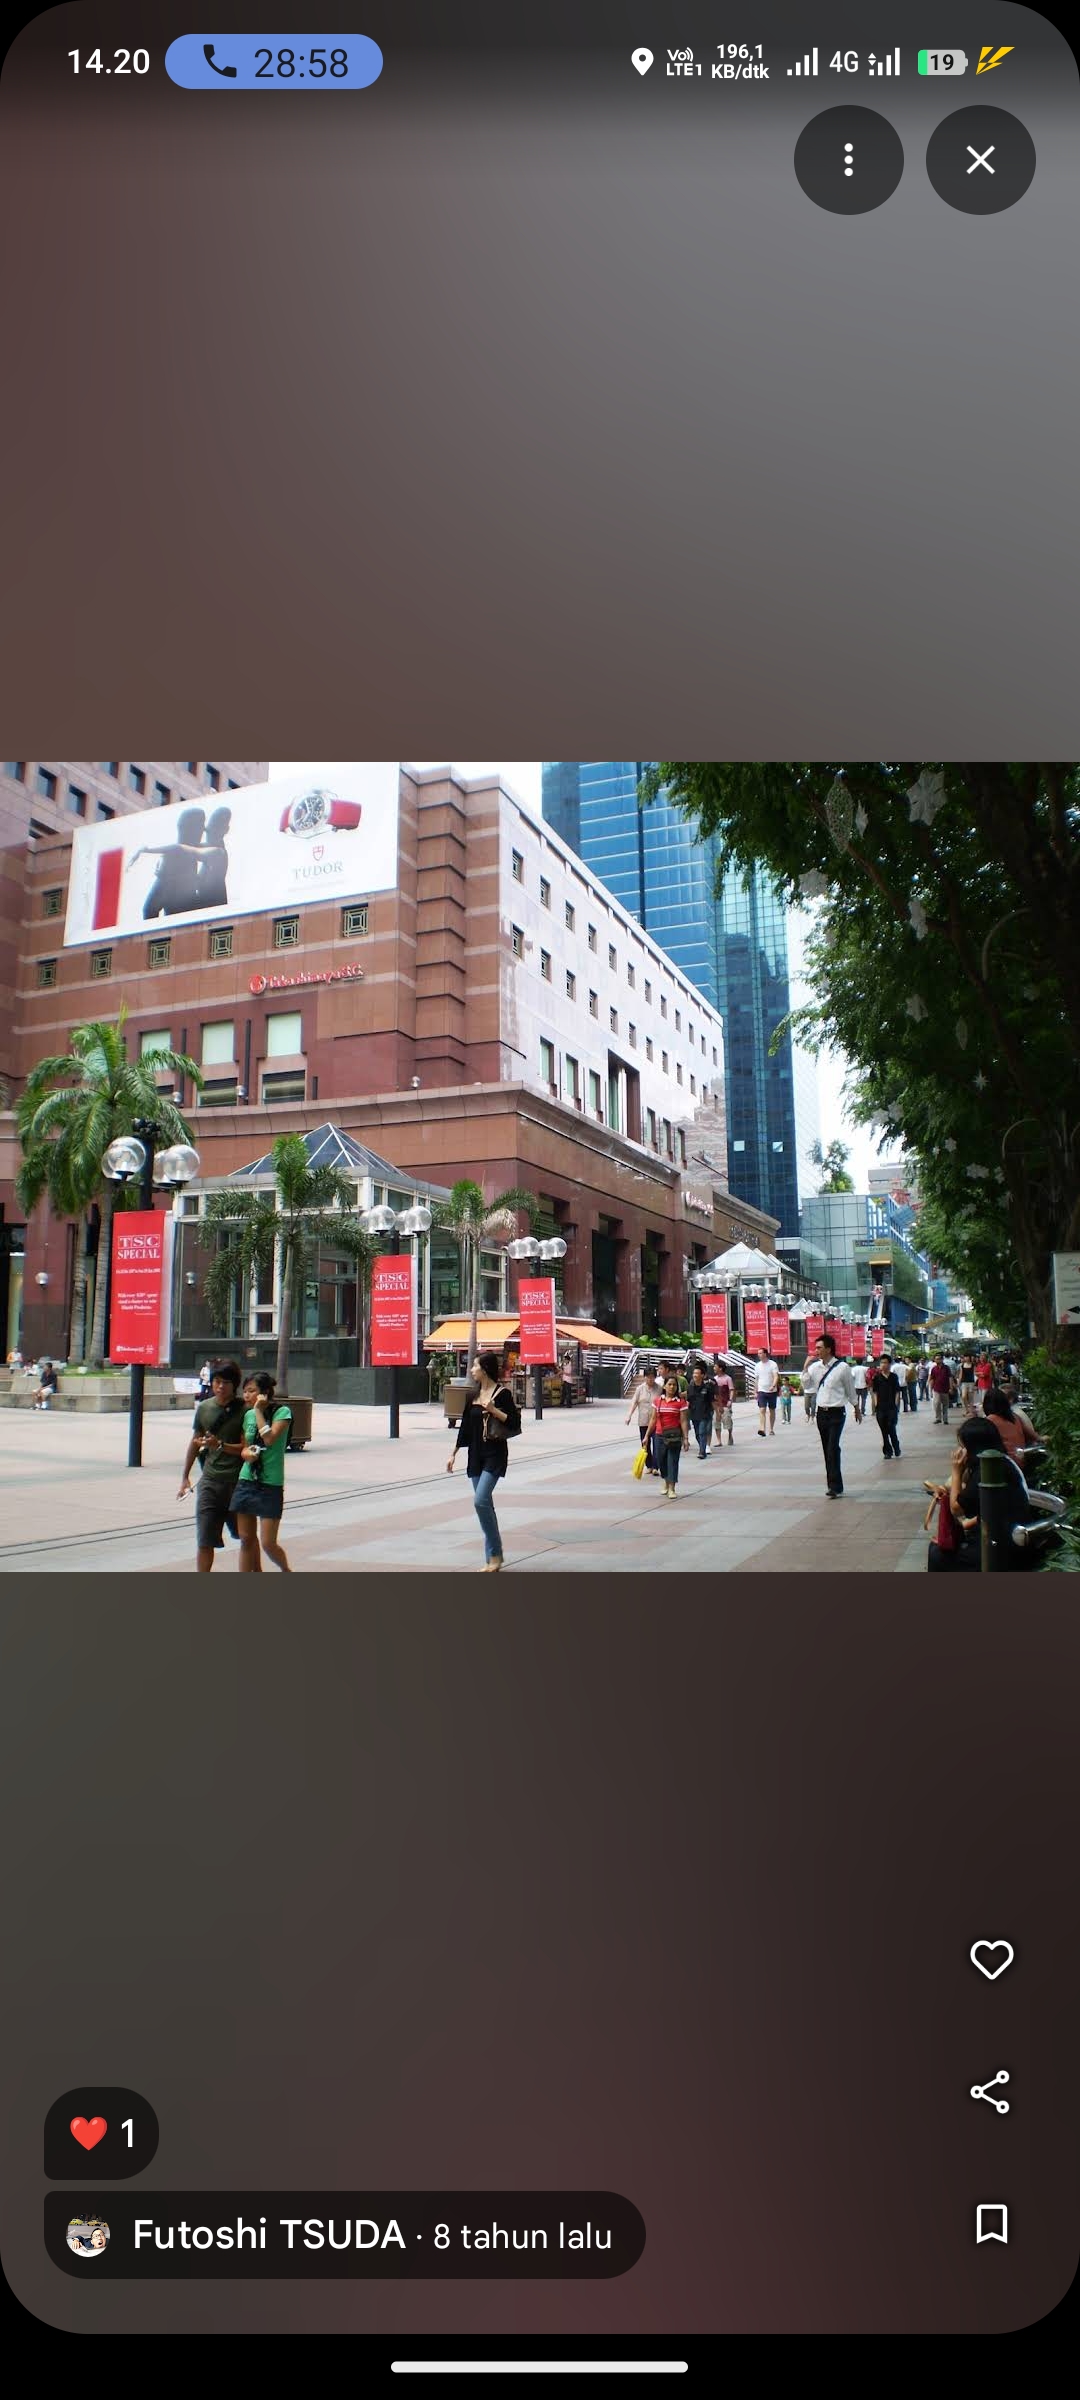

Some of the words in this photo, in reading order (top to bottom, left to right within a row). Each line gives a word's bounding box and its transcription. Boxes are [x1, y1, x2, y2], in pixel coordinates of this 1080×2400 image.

[293, 861, 344, 880] TUDOR
[118, 1235, 160, 1248] TSC
[117, 1248, 160, 1260] SPECIAL
[375, 1273, 409, 1282] TSC
[375, 1282, 409, 1291] SPECIAL
